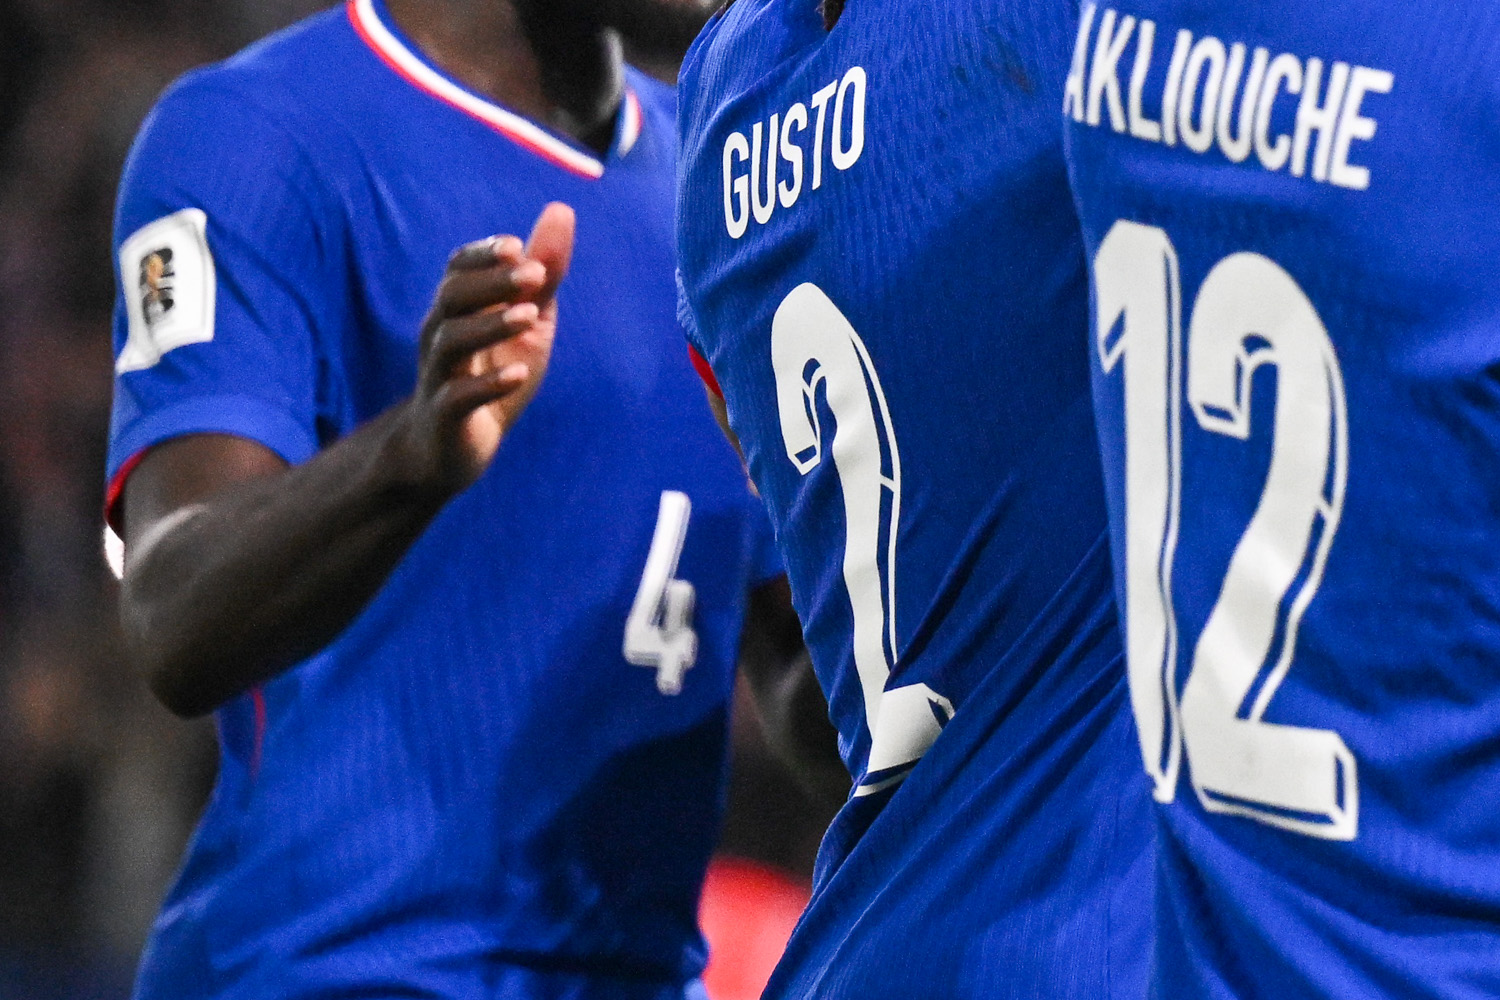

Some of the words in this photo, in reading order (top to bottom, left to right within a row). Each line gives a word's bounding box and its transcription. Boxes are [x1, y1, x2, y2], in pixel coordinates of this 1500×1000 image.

[723, 66, 866, 239] GUSTO
[1063, 3, 1394, 190] AKLIOUCHE
[623, 490, 698, 696] 4
[771, 282, 955, 797] 2
[1094, 219, 1359, 841] 12
